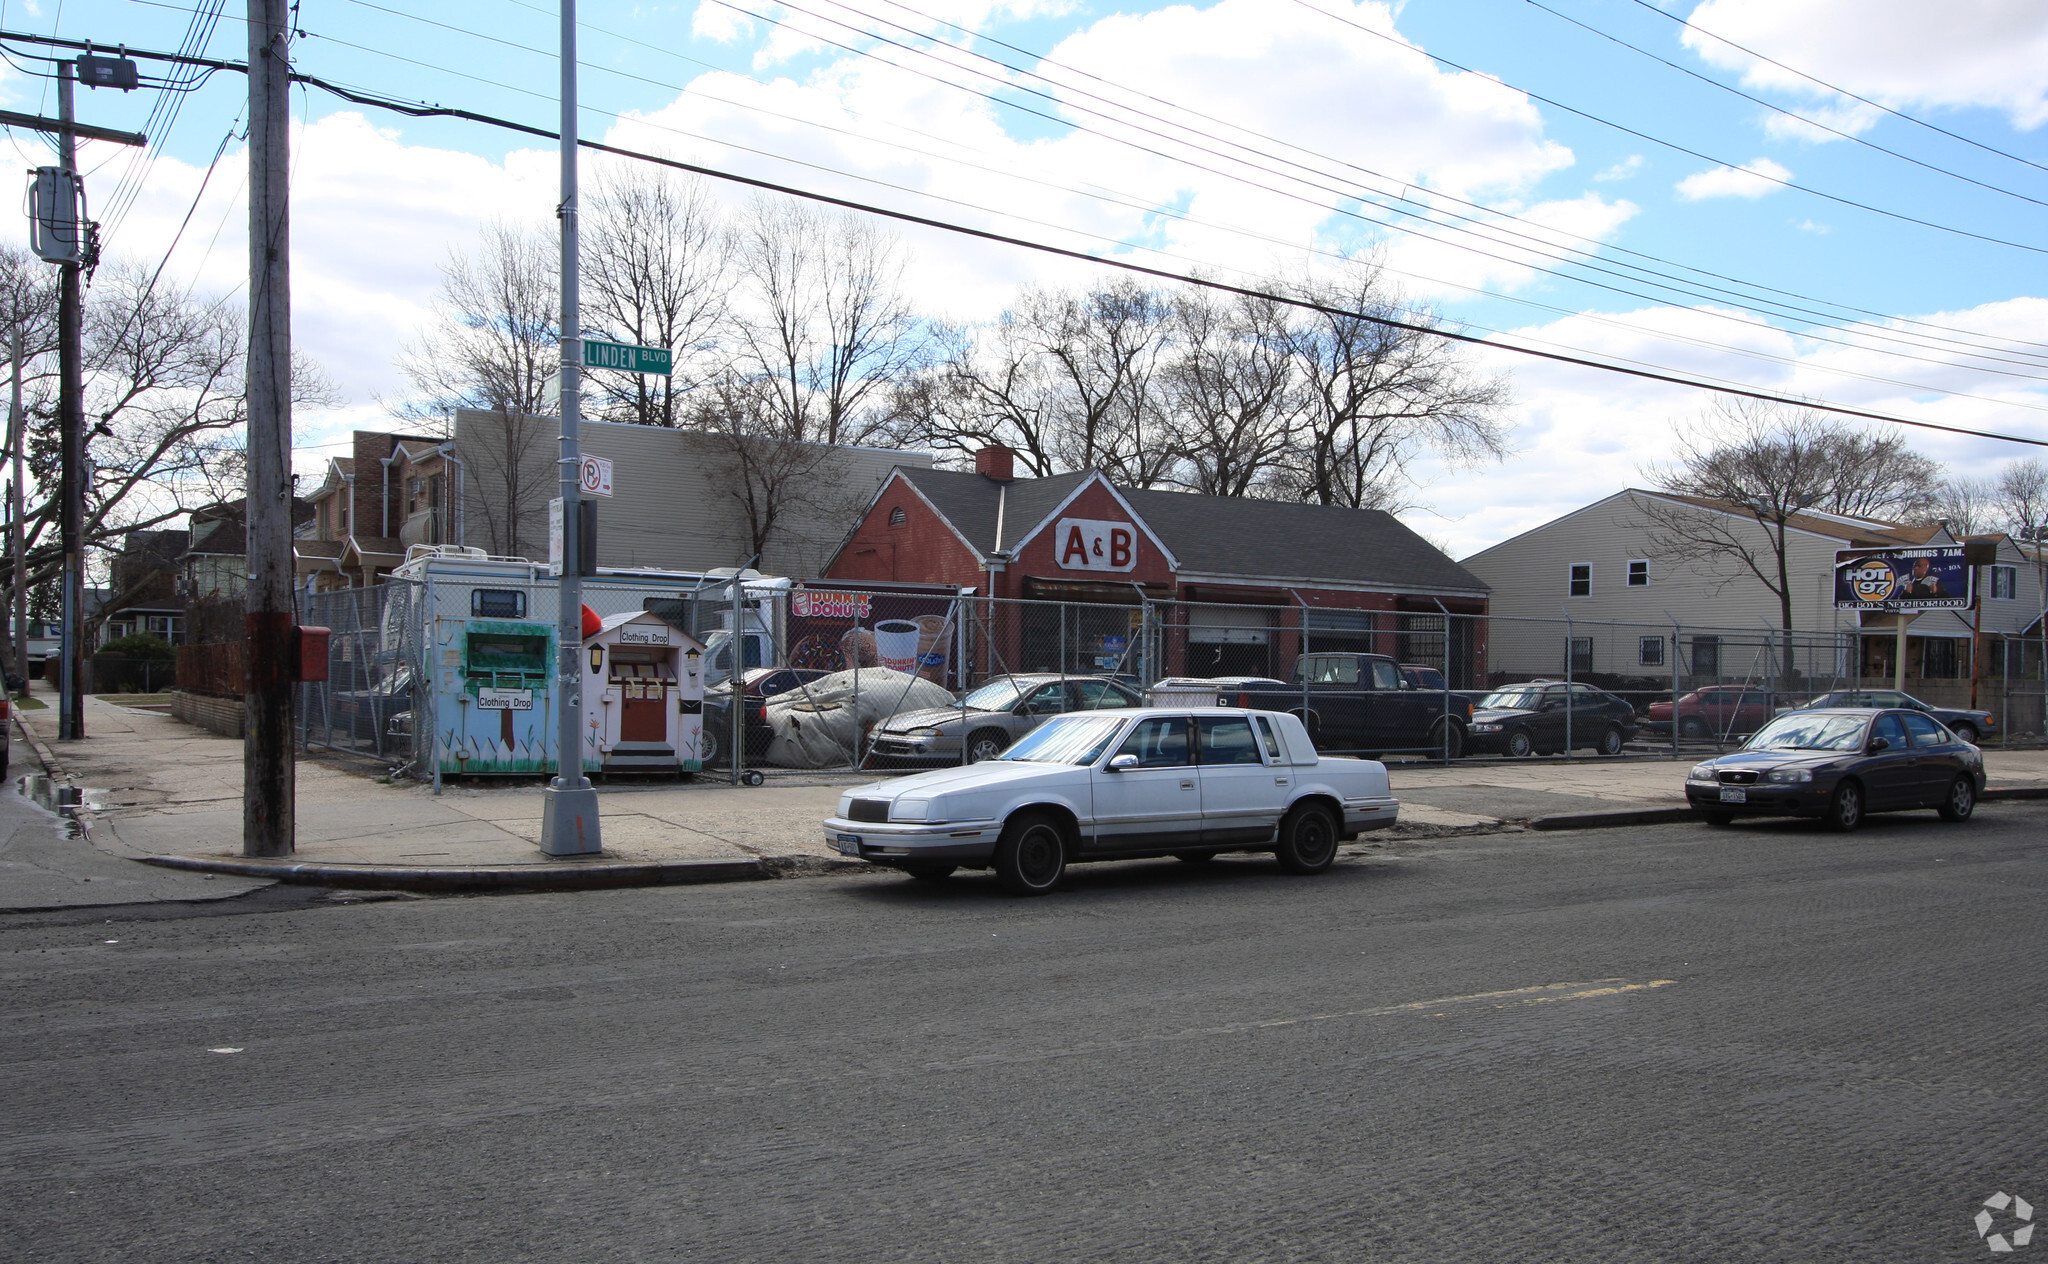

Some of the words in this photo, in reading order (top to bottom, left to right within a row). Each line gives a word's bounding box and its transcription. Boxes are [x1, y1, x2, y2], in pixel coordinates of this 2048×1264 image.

[587, 343, 636, 369] LINDEN
[641, 350, 668, 363] BLVD
[1062, 525, 1089, 565] A
[1093, 537, 1104, 557] &
[1111, 528, 1132, 567] B
[1942, 548, 1965, 557] 7AM.
[1845, 568, 1891, 581] HOT
[1859, 581, 1891, 594] 97
[811, 591, 872, 604] DUNKN'
[1887, 599, 1964, 608] NEIGHBORHOOD
[621, 632, 649, 643] Clothing
[652, 634, 668, 643] Drop
[480, 697, 510, 708] Clothing
[513, 698, 531, 709] Drop
